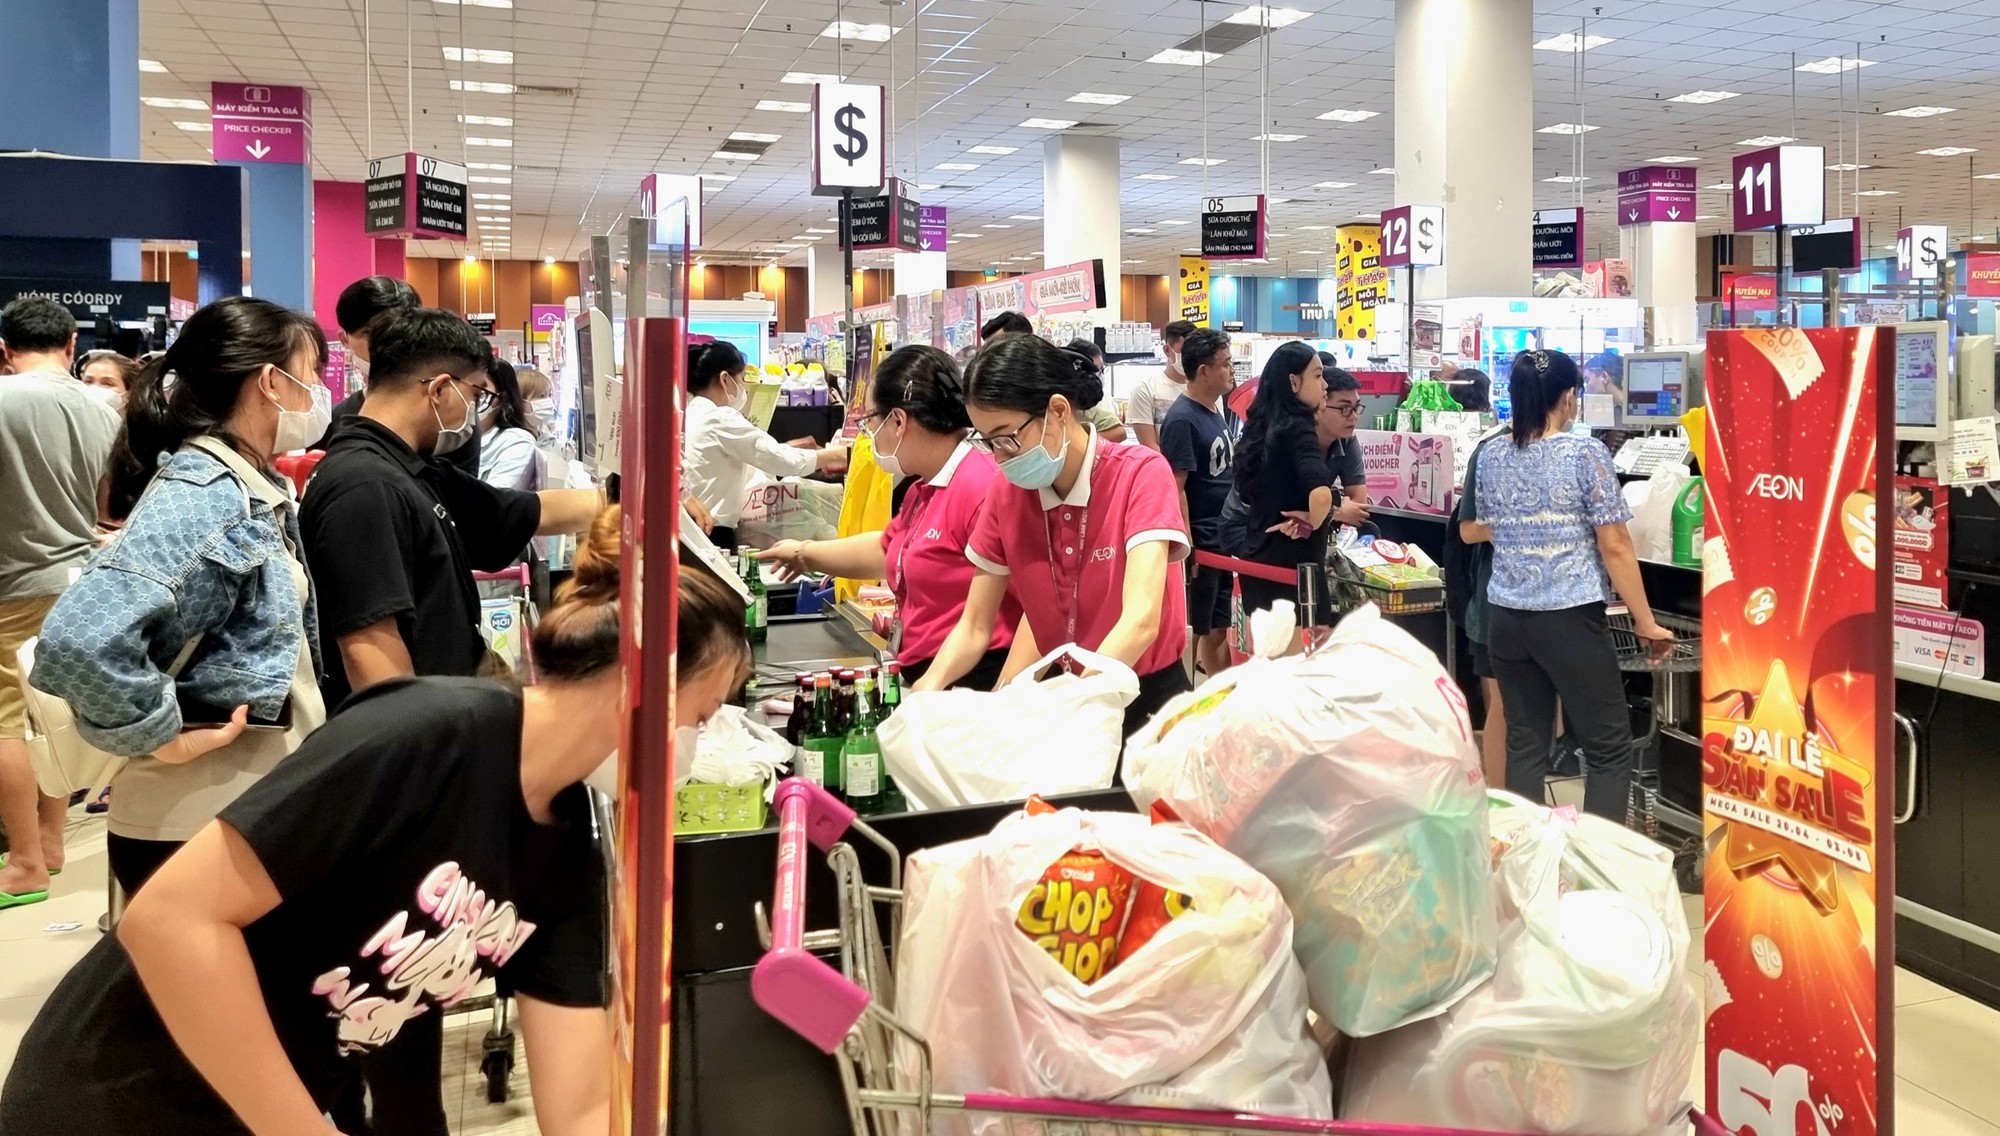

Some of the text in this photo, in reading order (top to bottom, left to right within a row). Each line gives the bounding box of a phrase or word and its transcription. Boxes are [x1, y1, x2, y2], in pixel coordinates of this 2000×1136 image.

[252, 126, 291, 134] CHECKER
[833, 102, 868, 166] $
[369, 161, 381, 178] 07
[422, 159, 437, 176] 07
[1739, 162, 1772, 215] 11
[454, 205, 462, 214] EM
[641, 188, 652, 218] 10
[1208, 199, 1224, 212] 05
[1208, 216, 1219, 224] SỮA
[1533, 211, 1541, 224] 4
[1382, 217, 1407, 256] 12
[1418, 217, 1434, 253] $
[1897, 237, 1910, 271] 14
[1920, 236, 1938, 268] $
[1363, 258, 1377, 266] GIÁ
[1356, 268, 1386, 286] THẤP
[1358, 288, 1375, 300] MỖI
[1363, 297, 1386, 308] NGÀY
[1362, 440, 1394, 455] ÍCH ĐIỂM
[1364, 458, 1399, 469] VOUCHER
[1917, 618, 1931, 627] TIỀN
[1933, 621, 1946, 631] MẶT
[1959, 626, 1978, 636] AEON
[1914, 647, 1931, 656] VISA
[1734, 724, 1824, 778] ĐẠI LỄ
[1703, 732, 1872, 846] SĂN SALE
[1710, 797, 1737, 814] MEGA
[1743, 808, 1771, 823] SALE
[1777, 819, 1809, 840] 20.04
[1017, 879, 1114, 936] CHOP
